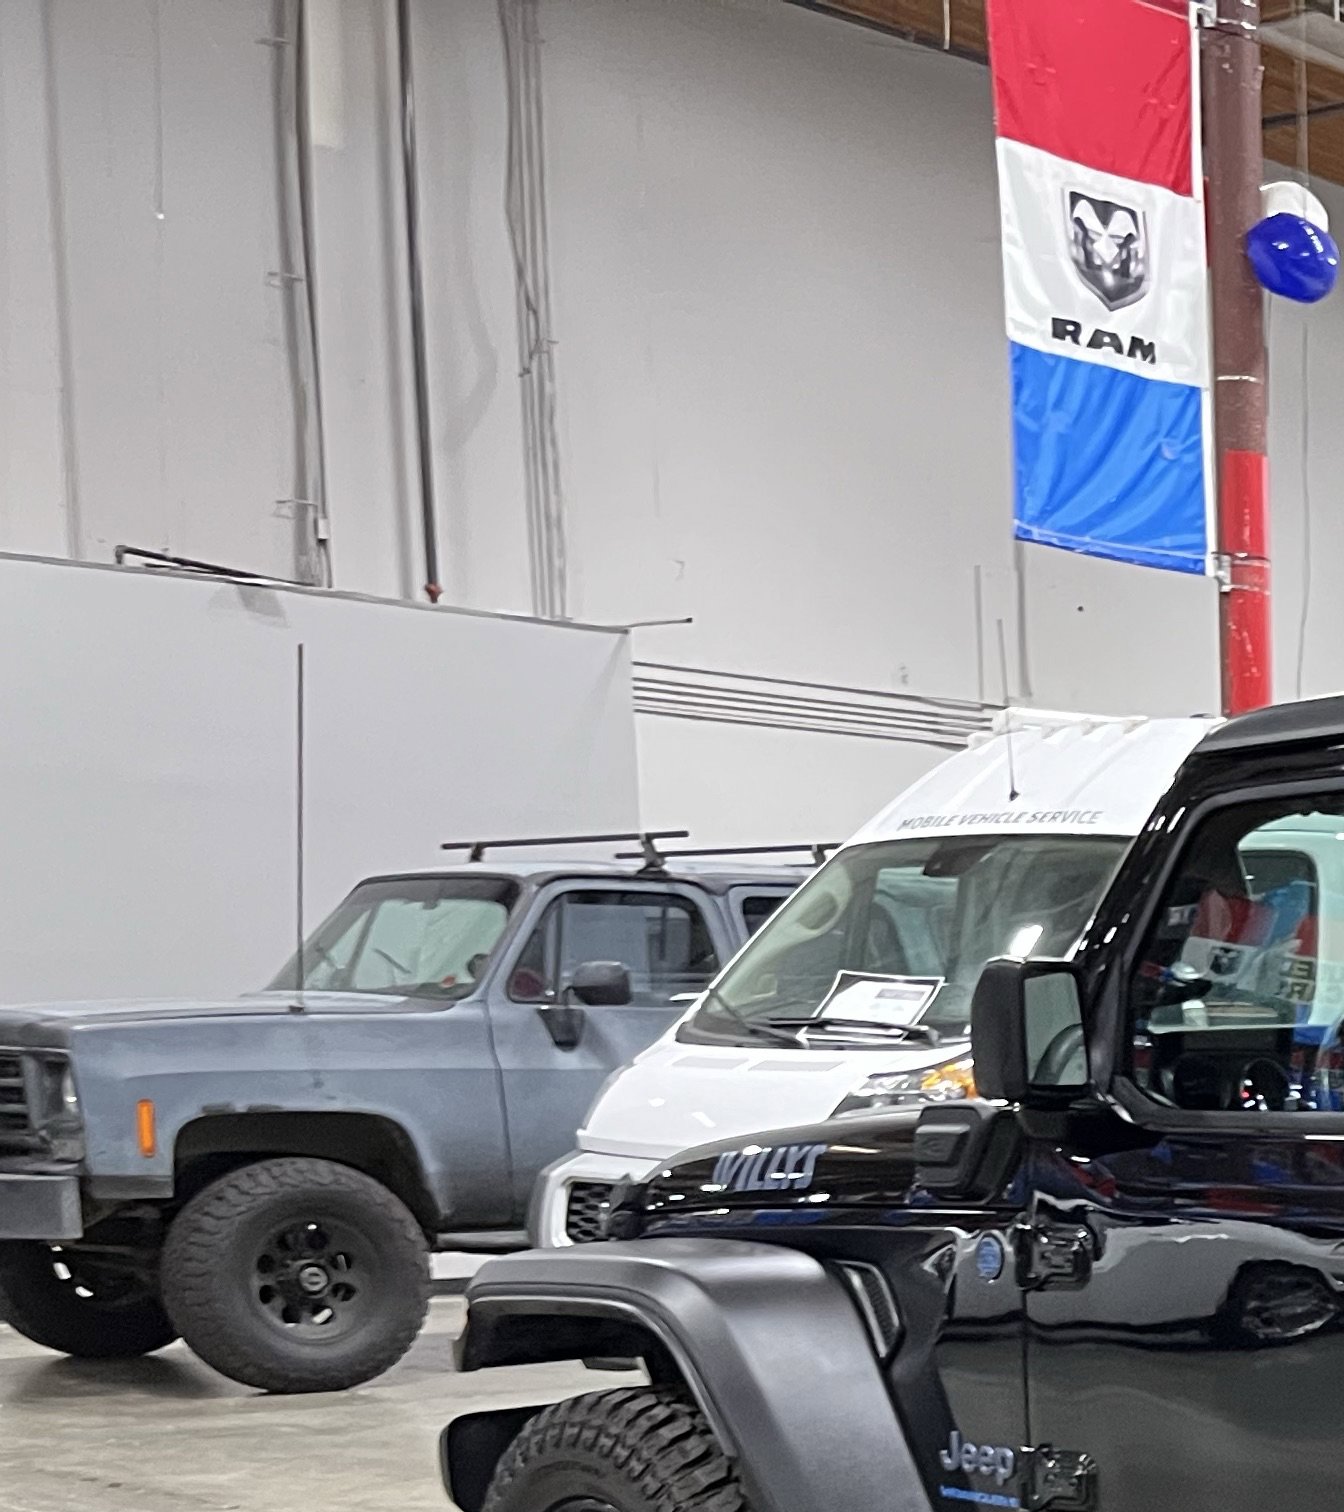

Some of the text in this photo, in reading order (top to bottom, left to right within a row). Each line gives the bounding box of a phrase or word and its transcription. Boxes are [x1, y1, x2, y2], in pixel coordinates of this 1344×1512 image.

[1051, 317, 1156, 365] RAM
[897, 810, 1104, 831] MOBILE VEHICLE SERVICE
[712, 1144, 828, 1192] WILLYS
[940, 1431, 1015, 1486] Jeep
